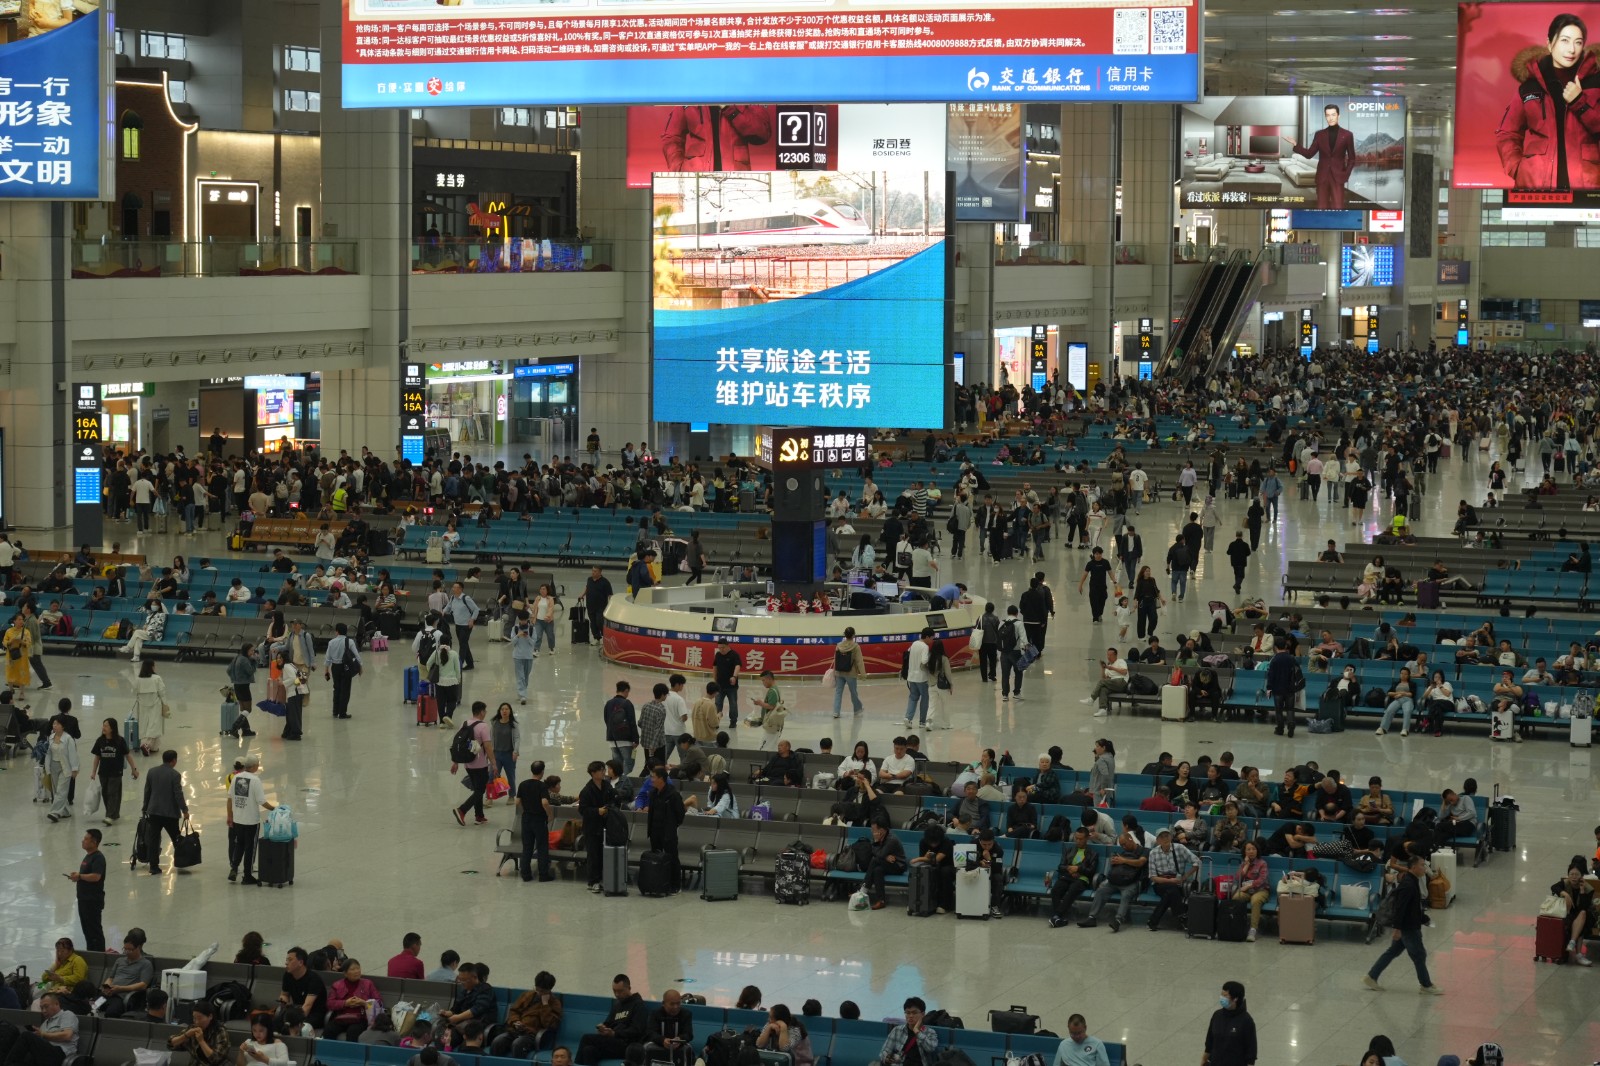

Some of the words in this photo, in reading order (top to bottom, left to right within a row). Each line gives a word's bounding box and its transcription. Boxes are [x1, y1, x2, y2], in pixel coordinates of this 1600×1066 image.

[1106, 66, 1154, 82] 信用卡
[1349, 103, 1384, 111] OPPEIN
[0, 101, 72, 126] 形象
[873, 138, 911, 149] 波司登
[779, 153, 810, 163] 12306
[814, 153, 826, 163] 12306
[0, 159, 72, 184] 文明
[436, 173, 465, 188] 麦当劳
[716, 347, 870, 375] 共享旅途生活
[404, 393, 422, 401] 14A
[716, 381, 871, 408] 维护站车秩序
[404, 403, 422, 411] 15A
[76, 418, 98, 428] 16A
[76, 429, 98, 440] 17A
[661, 643, 799, 671] 马廉务台
